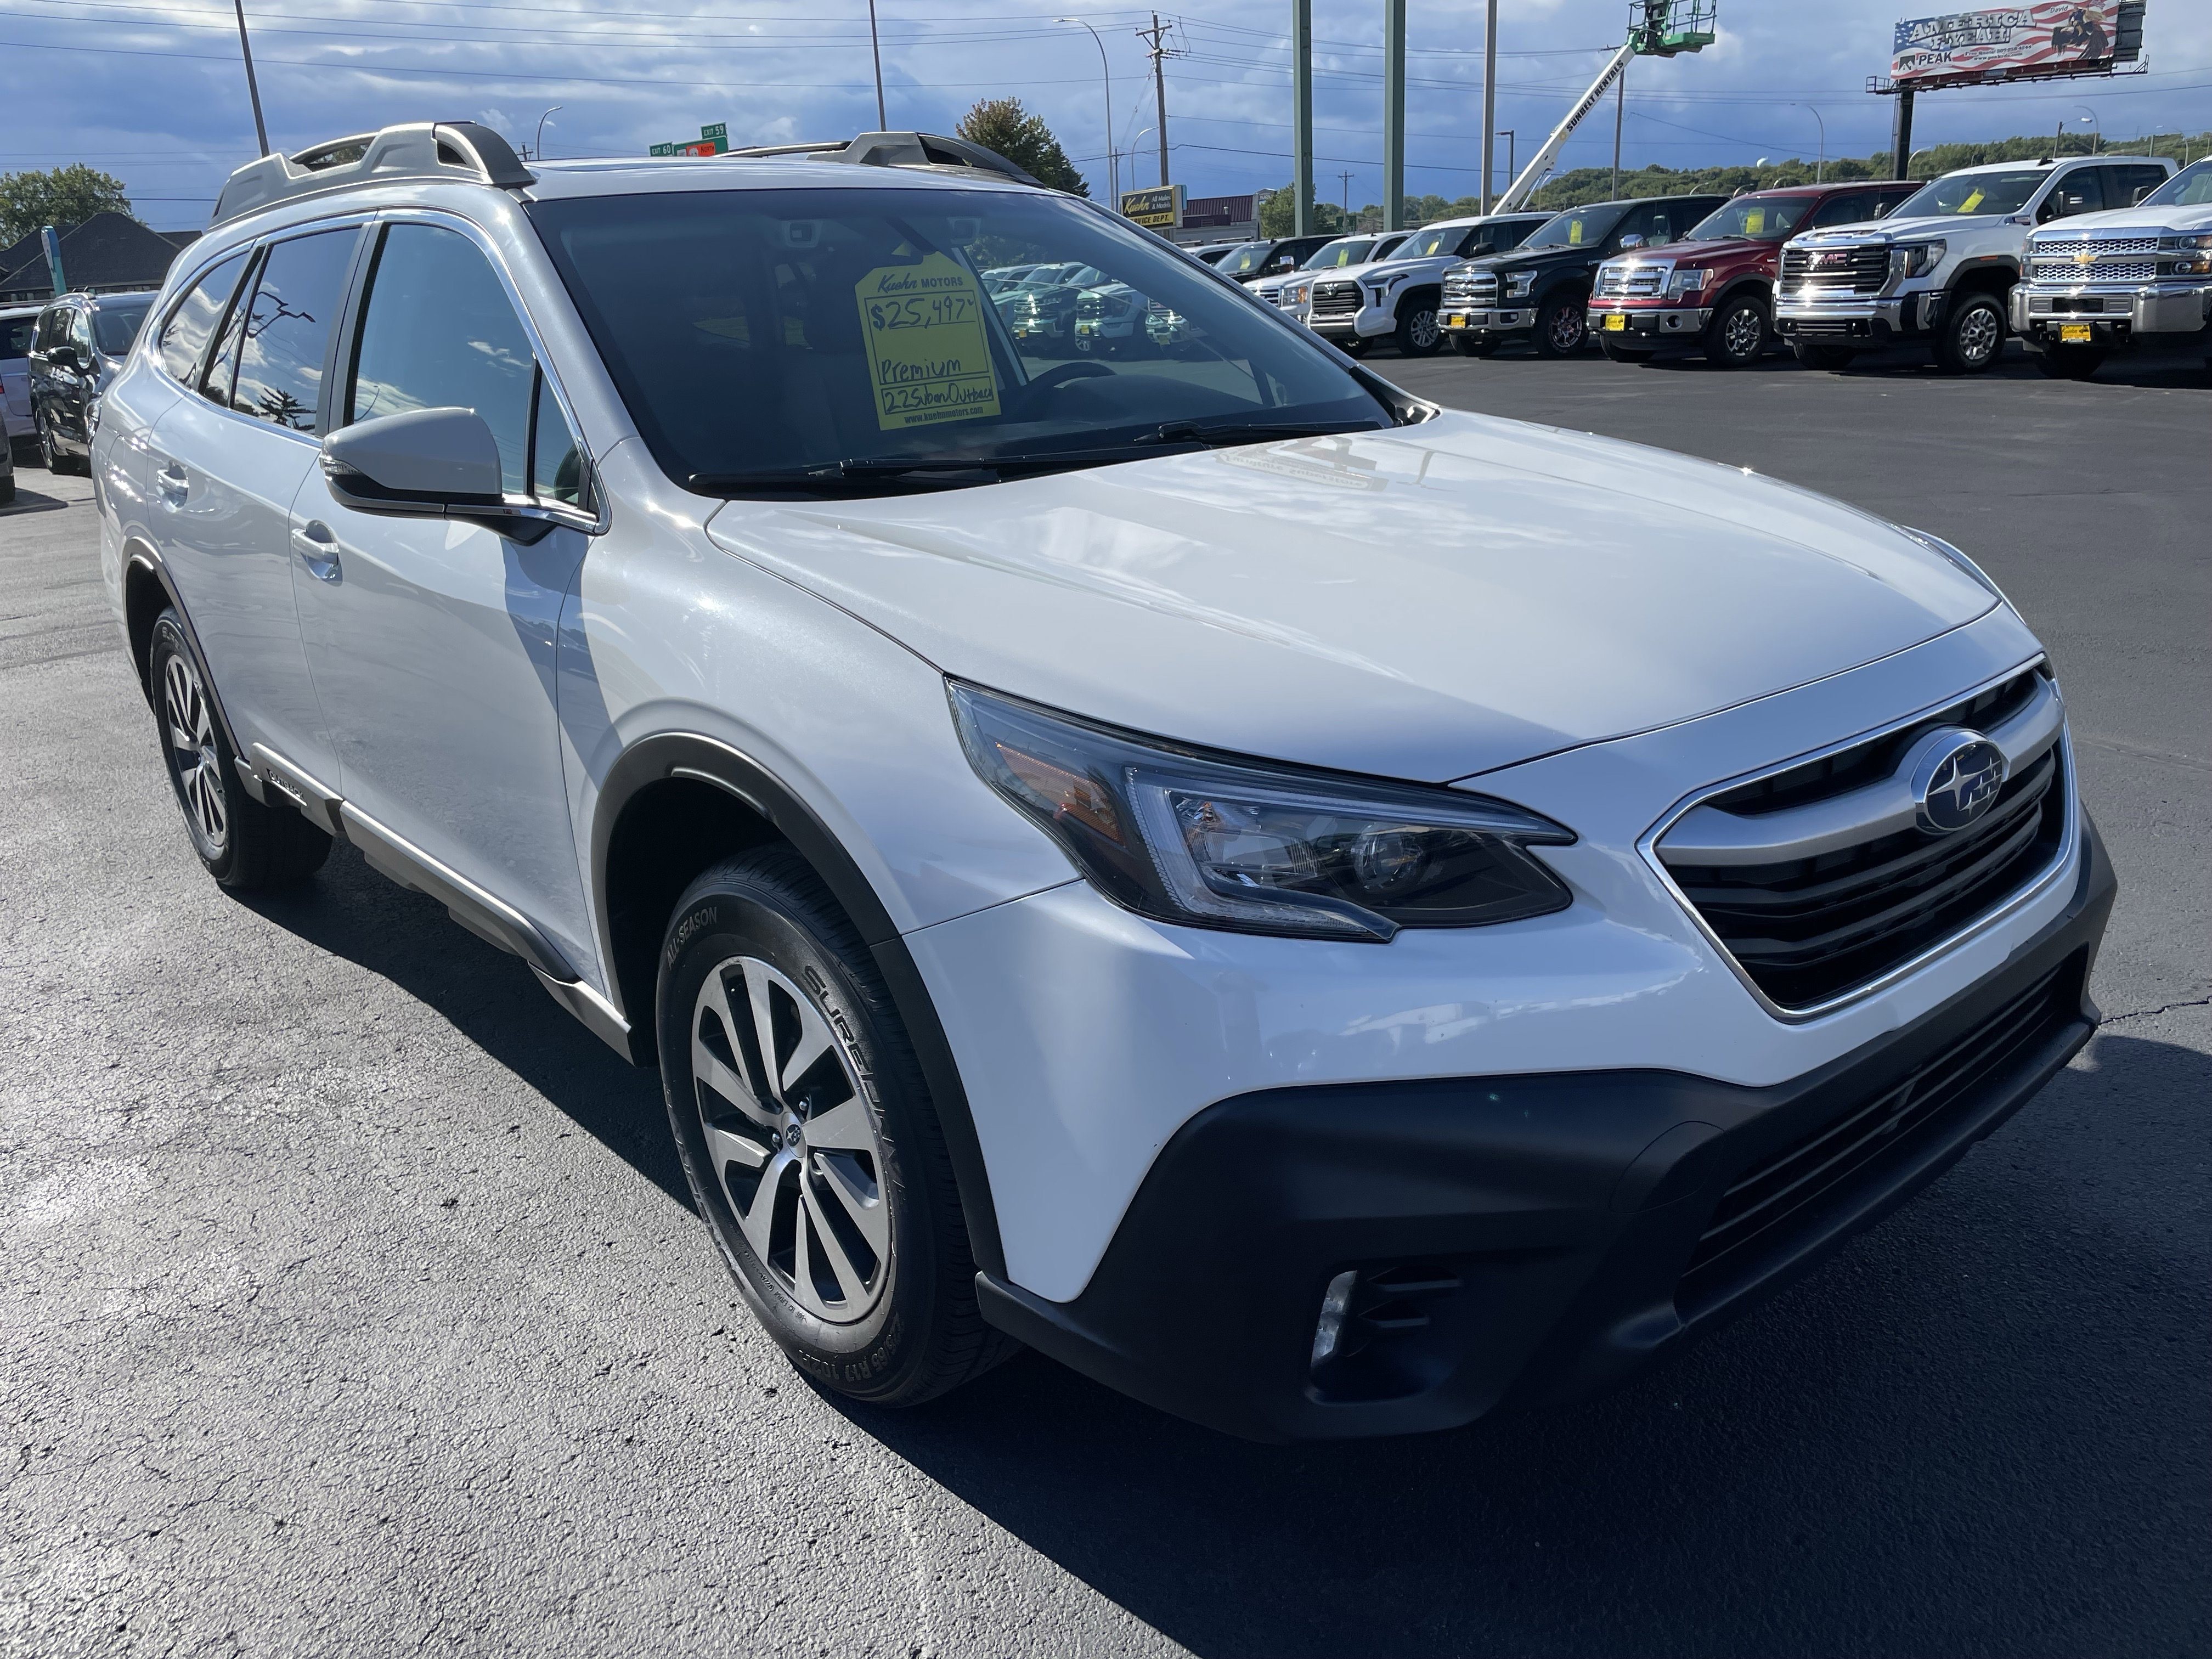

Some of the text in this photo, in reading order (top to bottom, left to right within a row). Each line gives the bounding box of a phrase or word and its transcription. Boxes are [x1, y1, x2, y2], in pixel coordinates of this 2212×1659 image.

[2050, 4, 2068, 14] David
[1909, 10, 2036, 42] AMERICA
[1918, 52, 1952, 65] PEAK
[1566, 59, 1624, 132] SUNBELT RENTALS
[715, 125, 724, 136] 59
[662, 144, 672, 155] 60
[1124, 195, 1150, 215] Kuehn
[877, 272, 964, 294] Kuehn MOTORS
[881, 358, 962, 384] Premium
[904, 407, 983, 424] www.kuehnmotors.com
[268, 770, 304, 799] OUTBACK
[667, 906, 718, 972] ALL-SEASON
